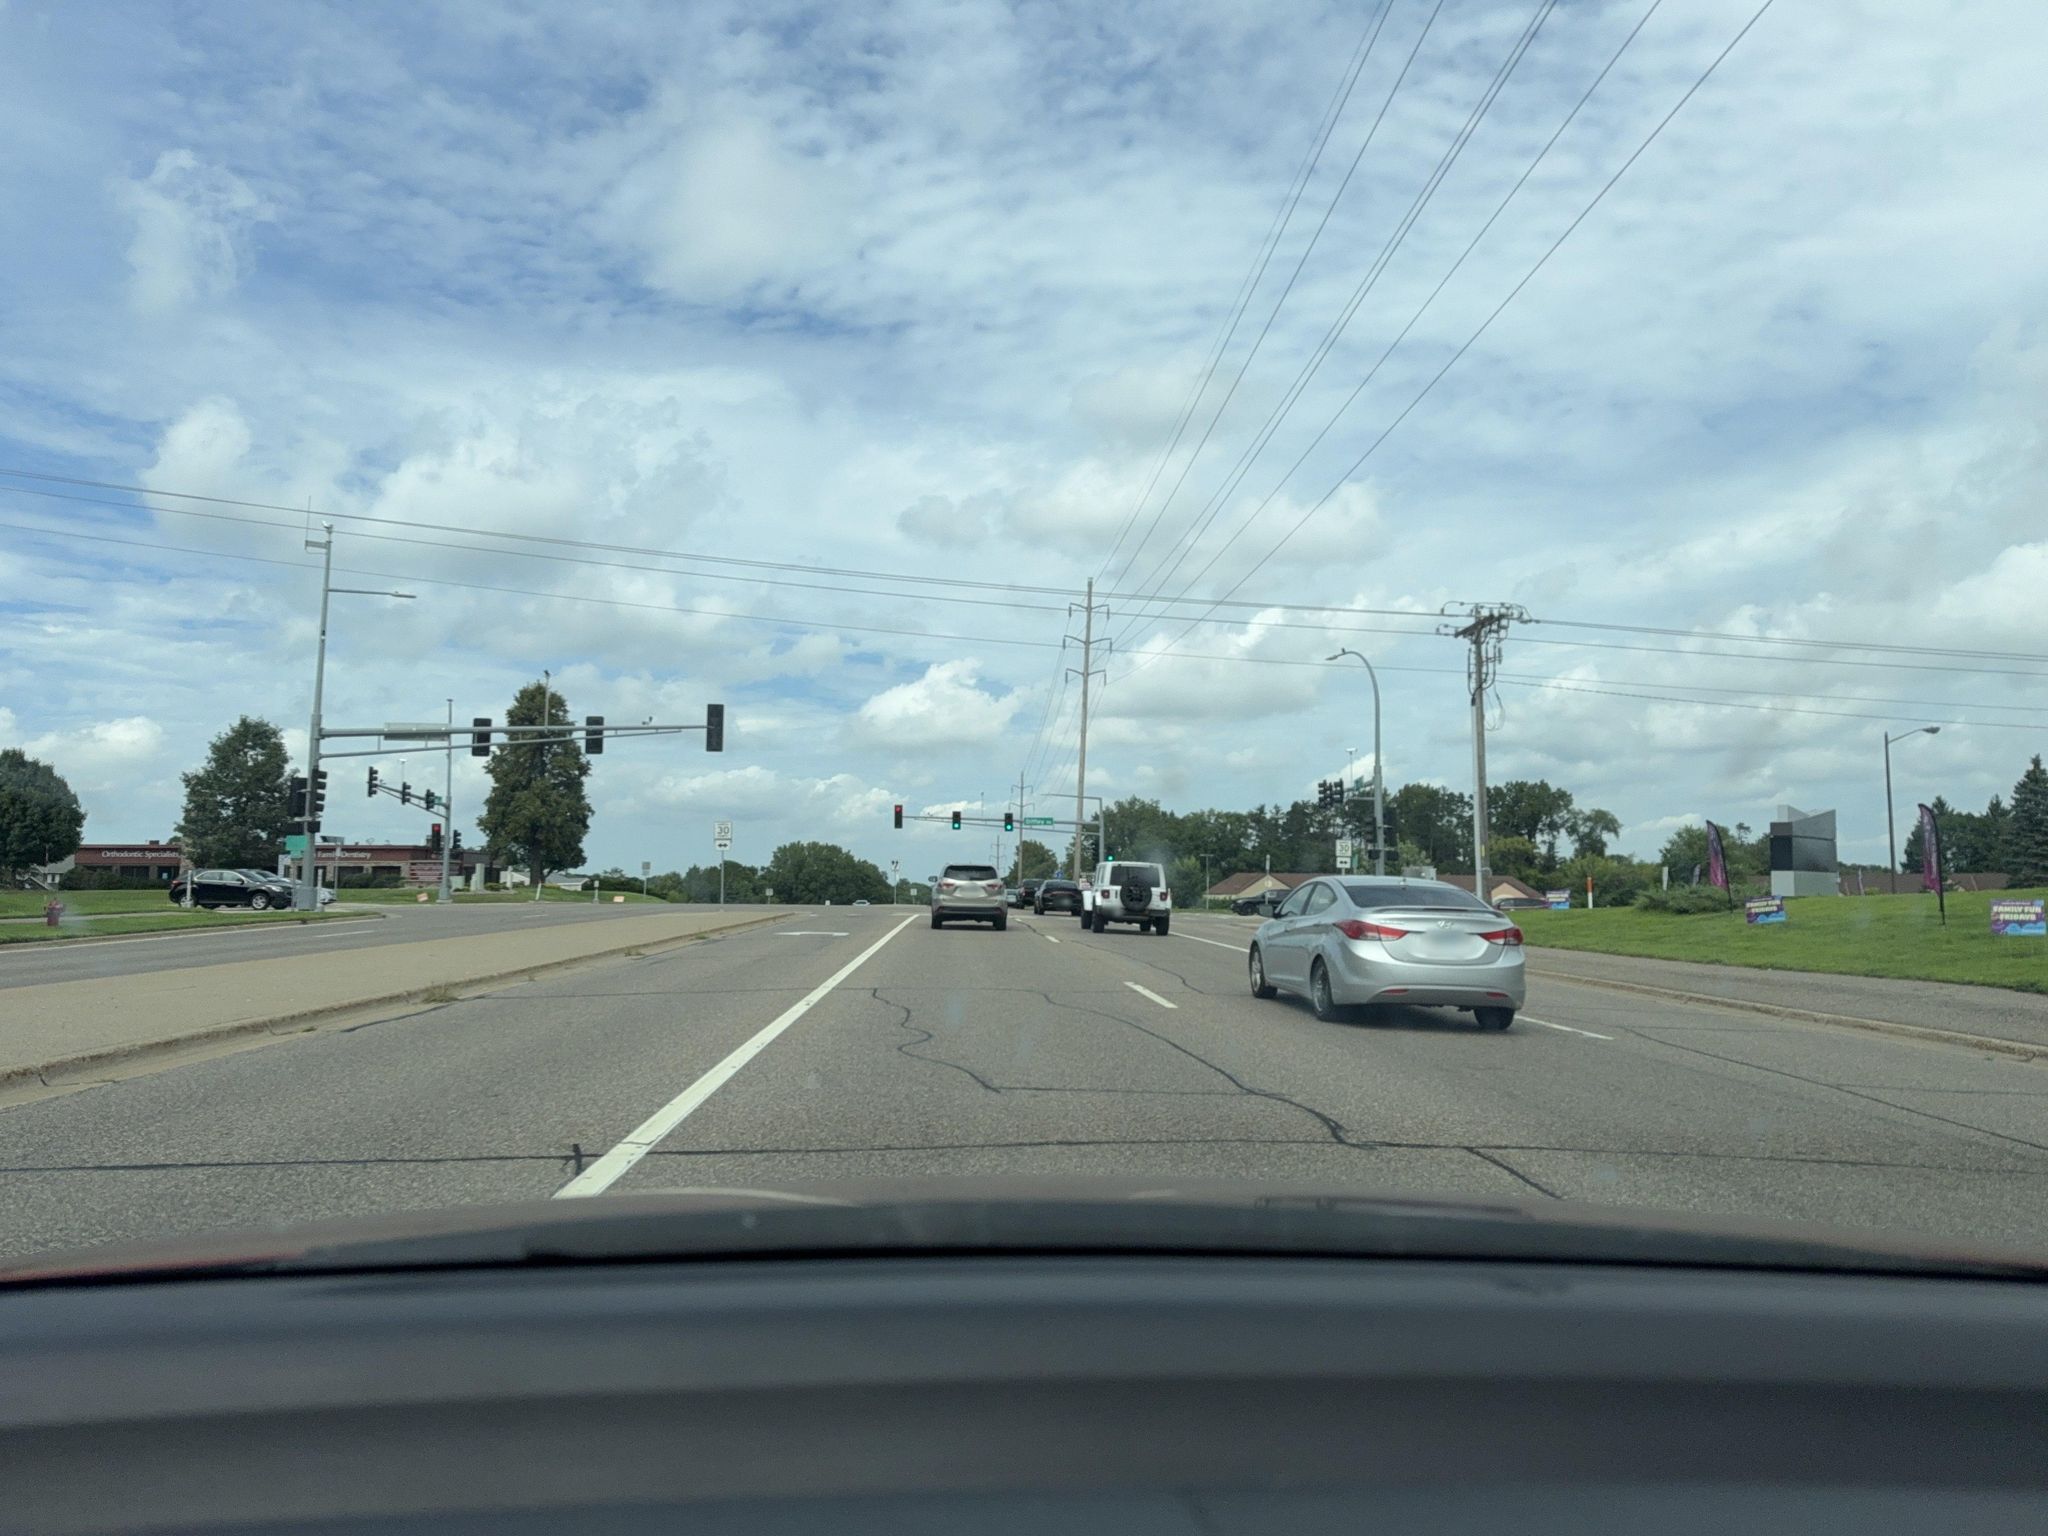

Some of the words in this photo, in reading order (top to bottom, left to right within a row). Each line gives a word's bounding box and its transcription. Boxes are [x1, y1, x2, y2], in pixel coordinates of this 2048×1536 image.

[717, 826, 730, 835] 30
[1339, 844, 1350, 853] 30
[144, 851, 179, 859] Specialists
[1993, 905, 2023, 913] FAMILY
[1999, 913, 2037, 921] FRIDAYS
